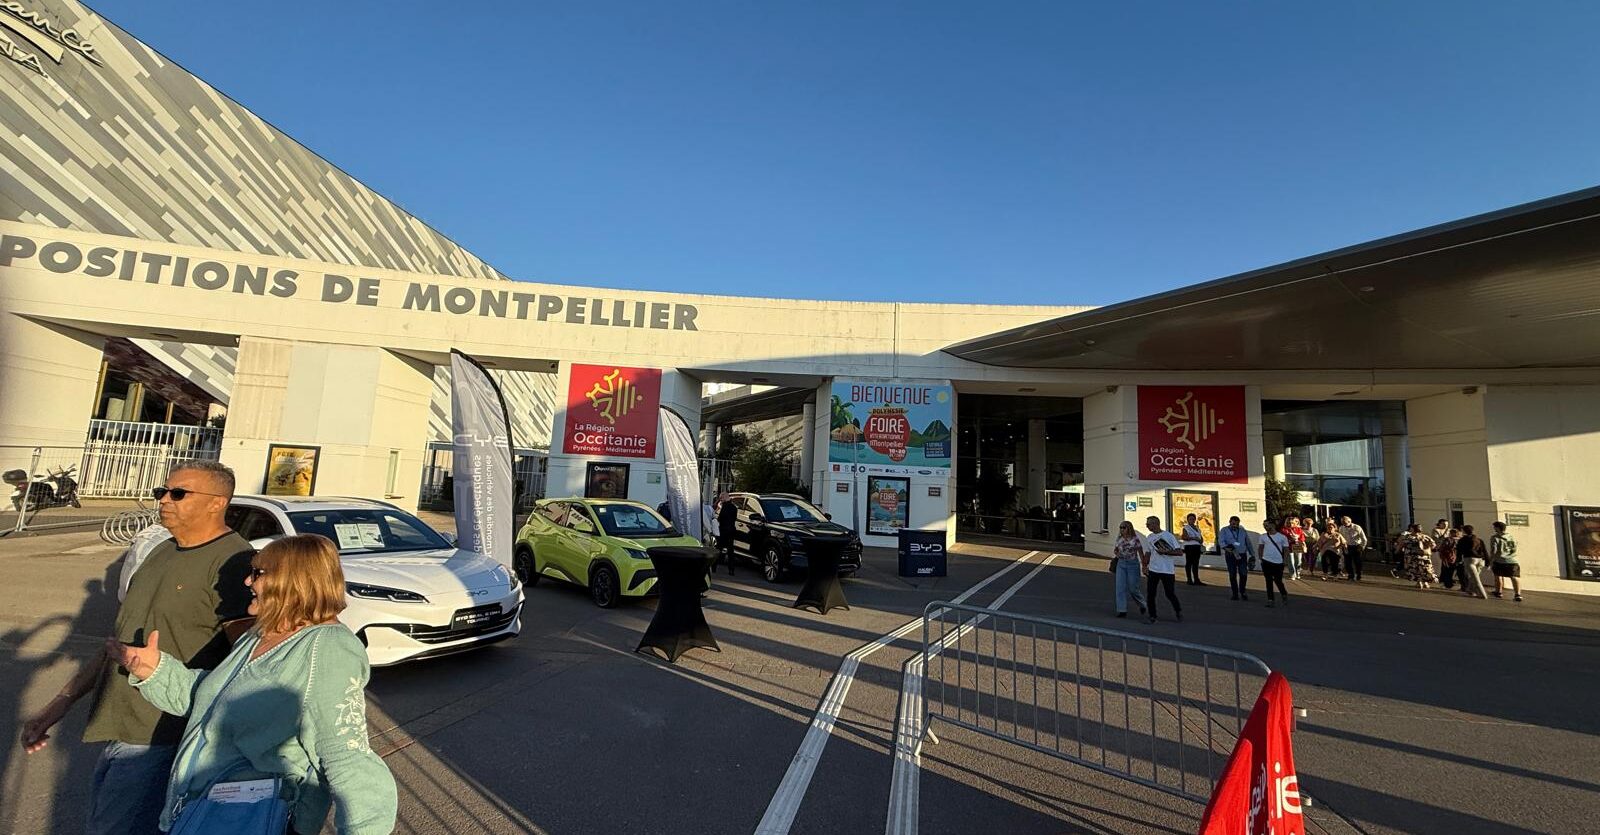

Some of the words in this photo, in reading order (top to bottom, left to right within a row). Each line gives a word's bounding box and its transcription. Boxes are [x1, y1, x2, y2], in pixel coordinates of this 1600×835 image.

[0, 233, 299, 298] POSITIONS
[320, 273, 380, 307] DE
[402, 282, 699, 331] MONTPELLIER
[851, 384, 932, 405] BIENVENUE
[574, 423, 585, 431] La
[585, 423, 616, 433] Région
[869, 417, 905, 433] FOIRE
[573, 431, 648, 448] Occitanie
[572, 444, 601, 452] Pyrénées
[605, 446, 646, 455] Méditerranée
[1159, 447, 1184, 455] Région
[1150, 454, 1235, 468] Occitanie
[1187, 468, 1235, 476] Méditerranée
[910, 543, 943, 552] BYD
